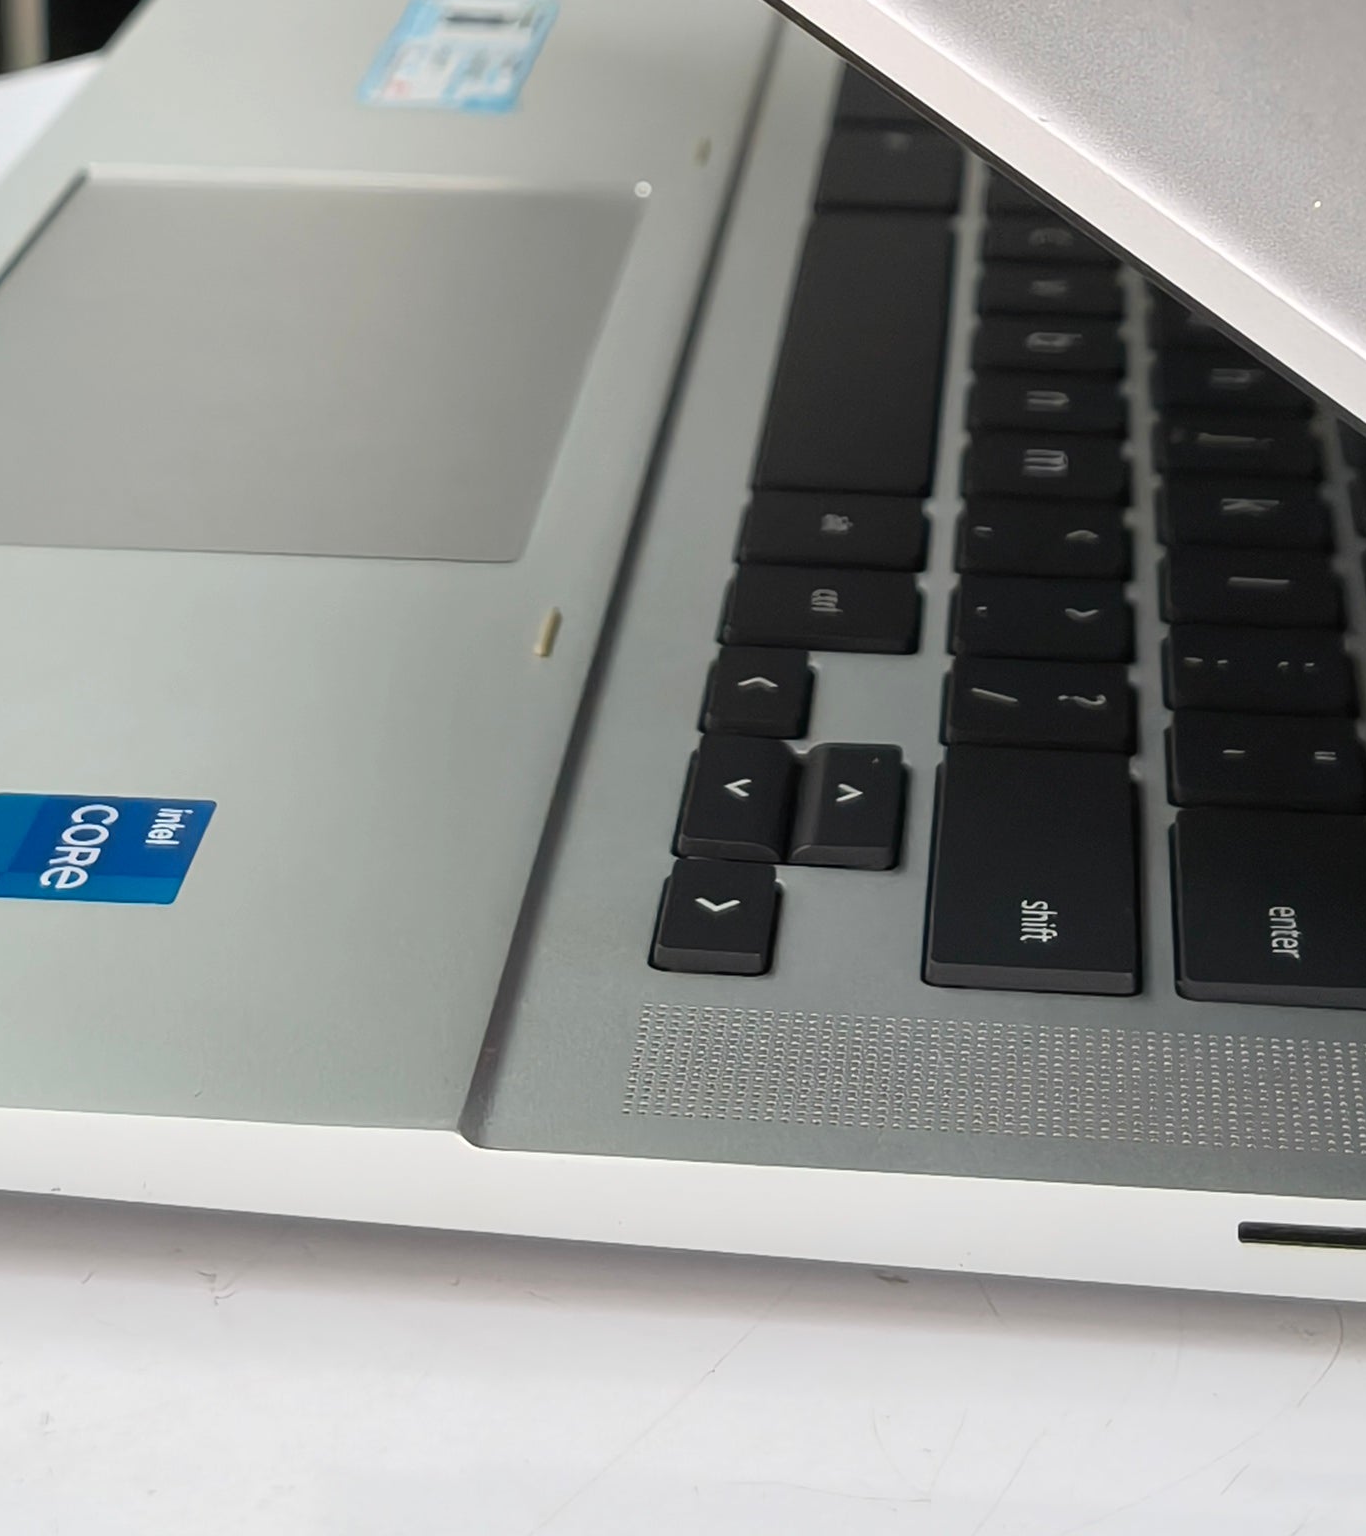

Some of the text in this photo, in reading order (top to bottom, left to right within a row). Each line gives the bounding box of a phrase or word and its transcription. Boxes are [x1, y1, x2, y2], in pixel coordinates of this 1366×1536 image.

[1023, 448, 1069, 476] m
[1220, 497, 1280, 515] k
[144, 806, 194, 847] intel
[1019, 899, 1059, 944] shift
[1268, 905, 1302, 960] enter
